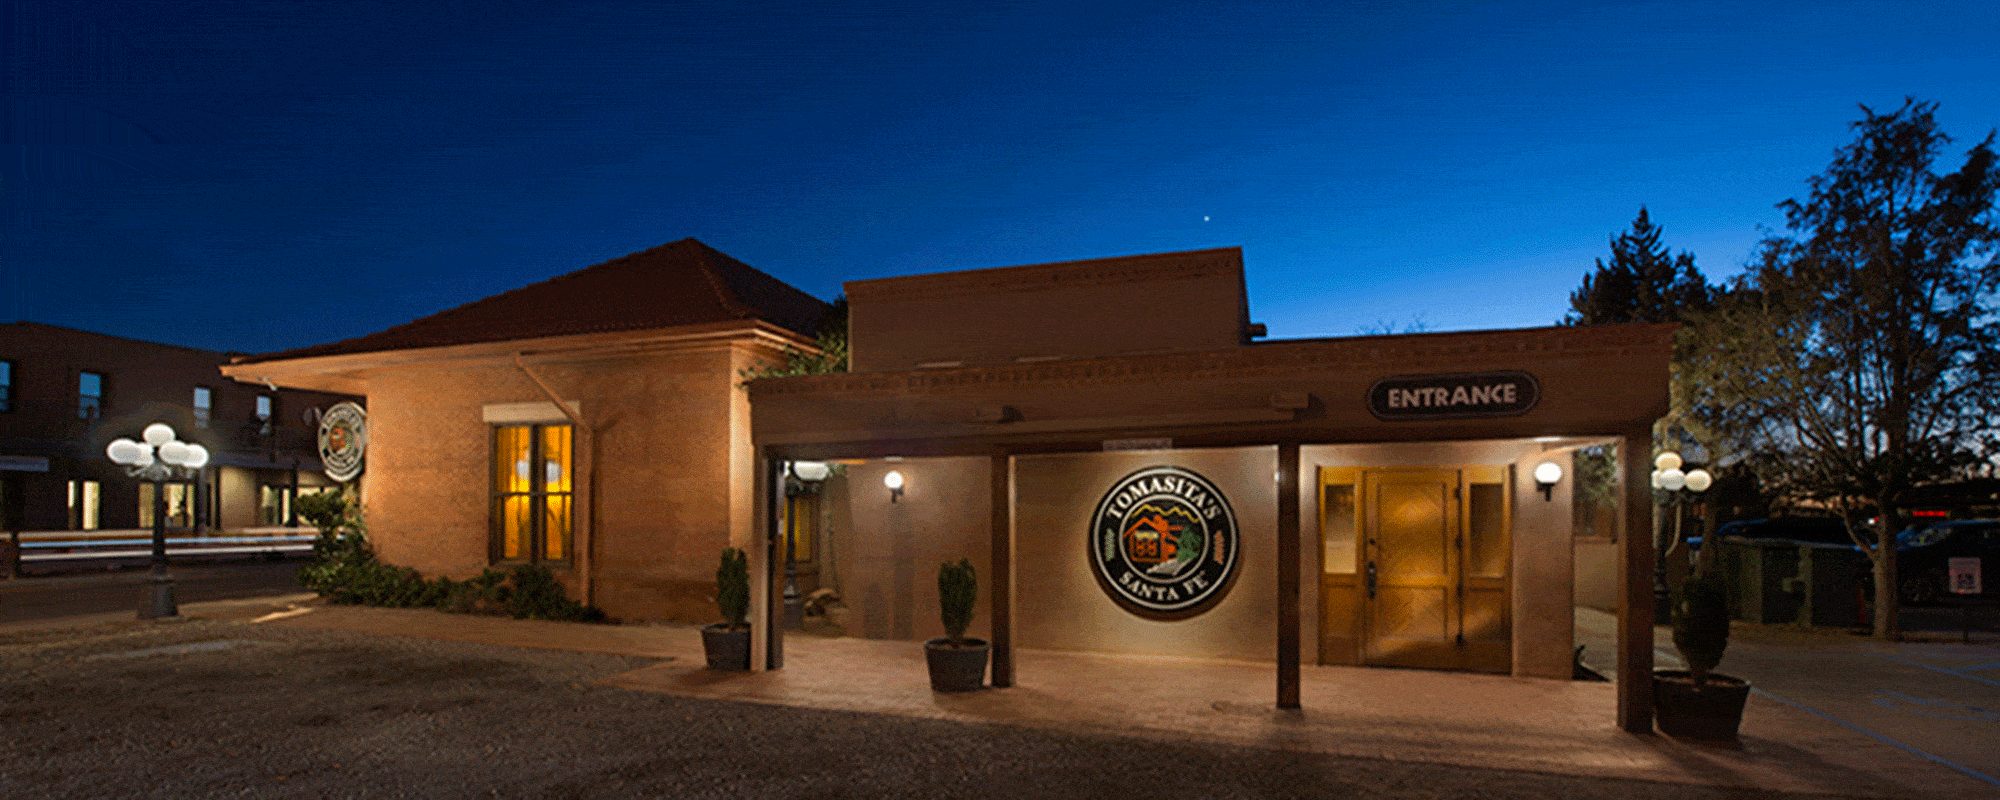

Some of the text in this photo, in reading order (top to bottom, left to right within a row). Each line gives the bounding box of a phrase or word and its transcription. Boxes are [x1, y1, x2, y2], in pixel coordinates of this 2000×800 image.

[1388, 383, 1517, 408] ENTRANCE
[1106, 476, 1221, 520] TOMASITA'S
[1119, 571, 1180, 601] SANTA
